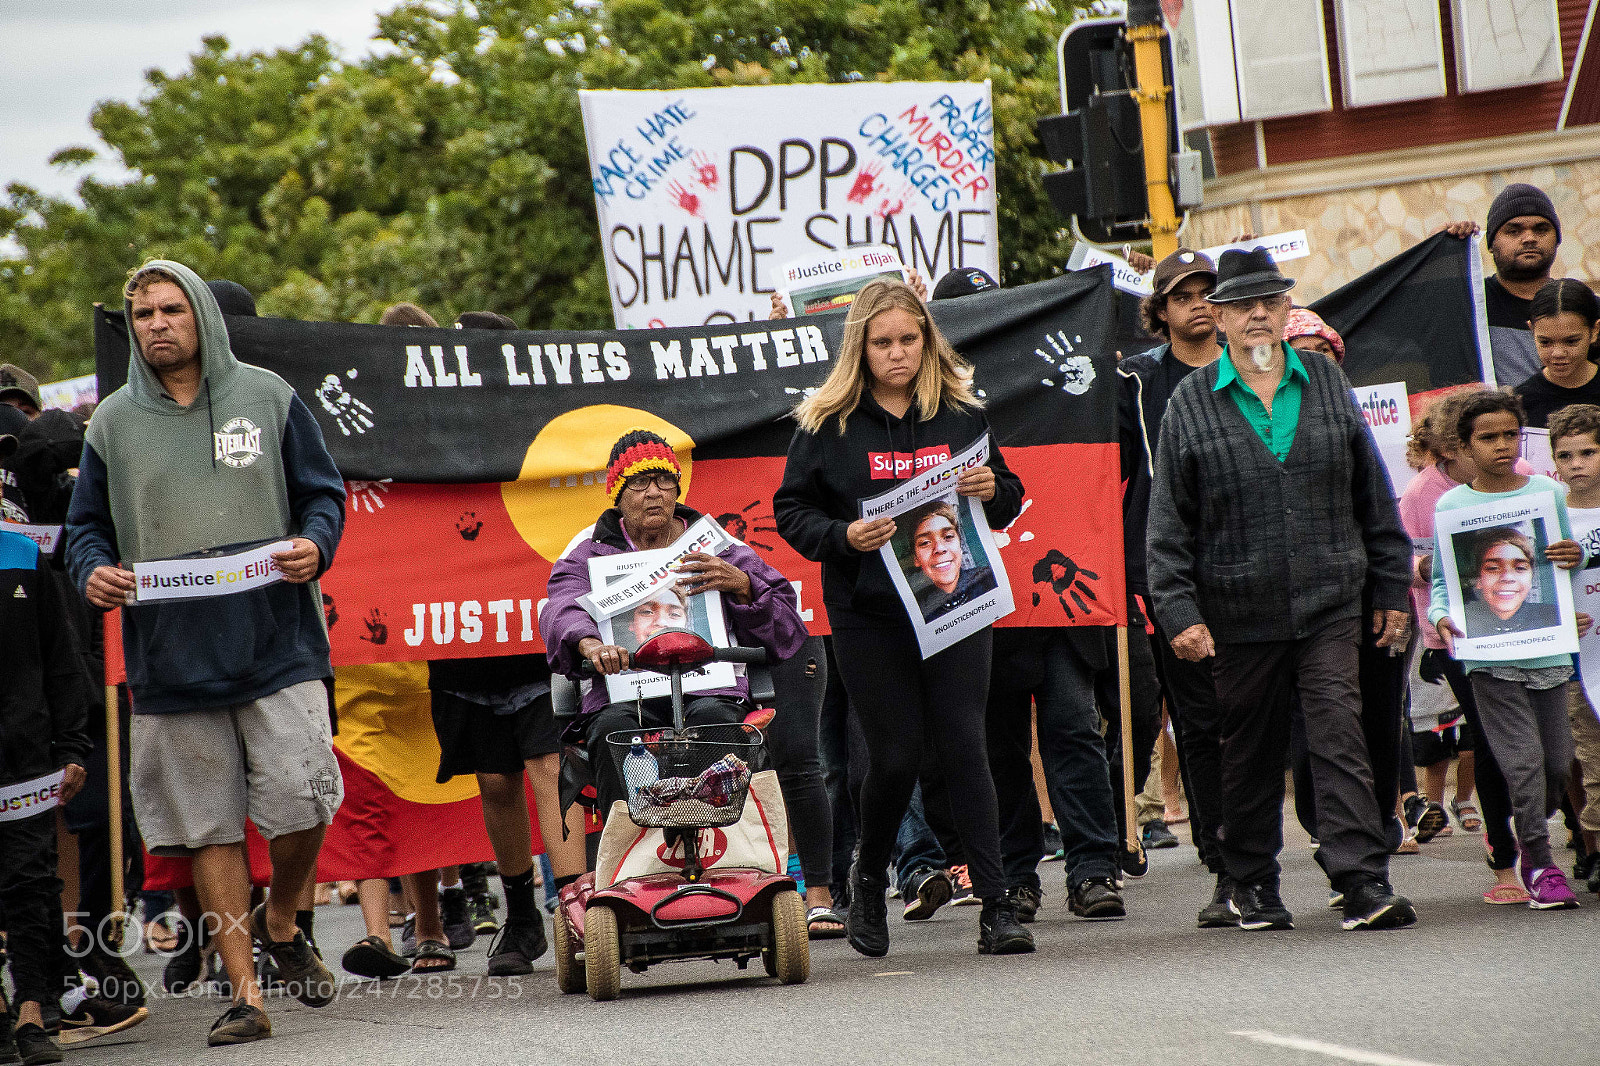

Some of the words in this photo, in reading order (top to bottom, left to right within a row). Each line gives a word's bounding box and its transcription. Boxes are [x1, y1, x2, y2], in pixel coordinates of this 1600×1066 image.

[593, 138, 643, 208] RACE
[637, 99, 697, 145] HATE
[859, 112, 961, 212] CHARGES
[898, 104, 990, 202] MURDER
[930, 94, 996, 172] PROPER
[625, 136, 694, 200] CRIME
[730, 136, 858, 216] DPP
[611, 217, 782, 309] SHAME
[404, 345, 482, 387] ALL
[501, 341, 631, 386] LIVES
[650, 325, 829, 380] MATTER
[214, 427, 264, 460] EVERLAST
[874, 452, 949, 476] Supreme
[866, 497, 895, 517] WHERE
[896, 494, 905, 505] IS
[906, 486, 920, 500] THE
[597, 592, 624, 609] WHERE
[622, 588, 634, 599] IS
[632, 580, 649, 592] THE
[934, 598, 997, 635] #NOJUSTICENOPEACE
